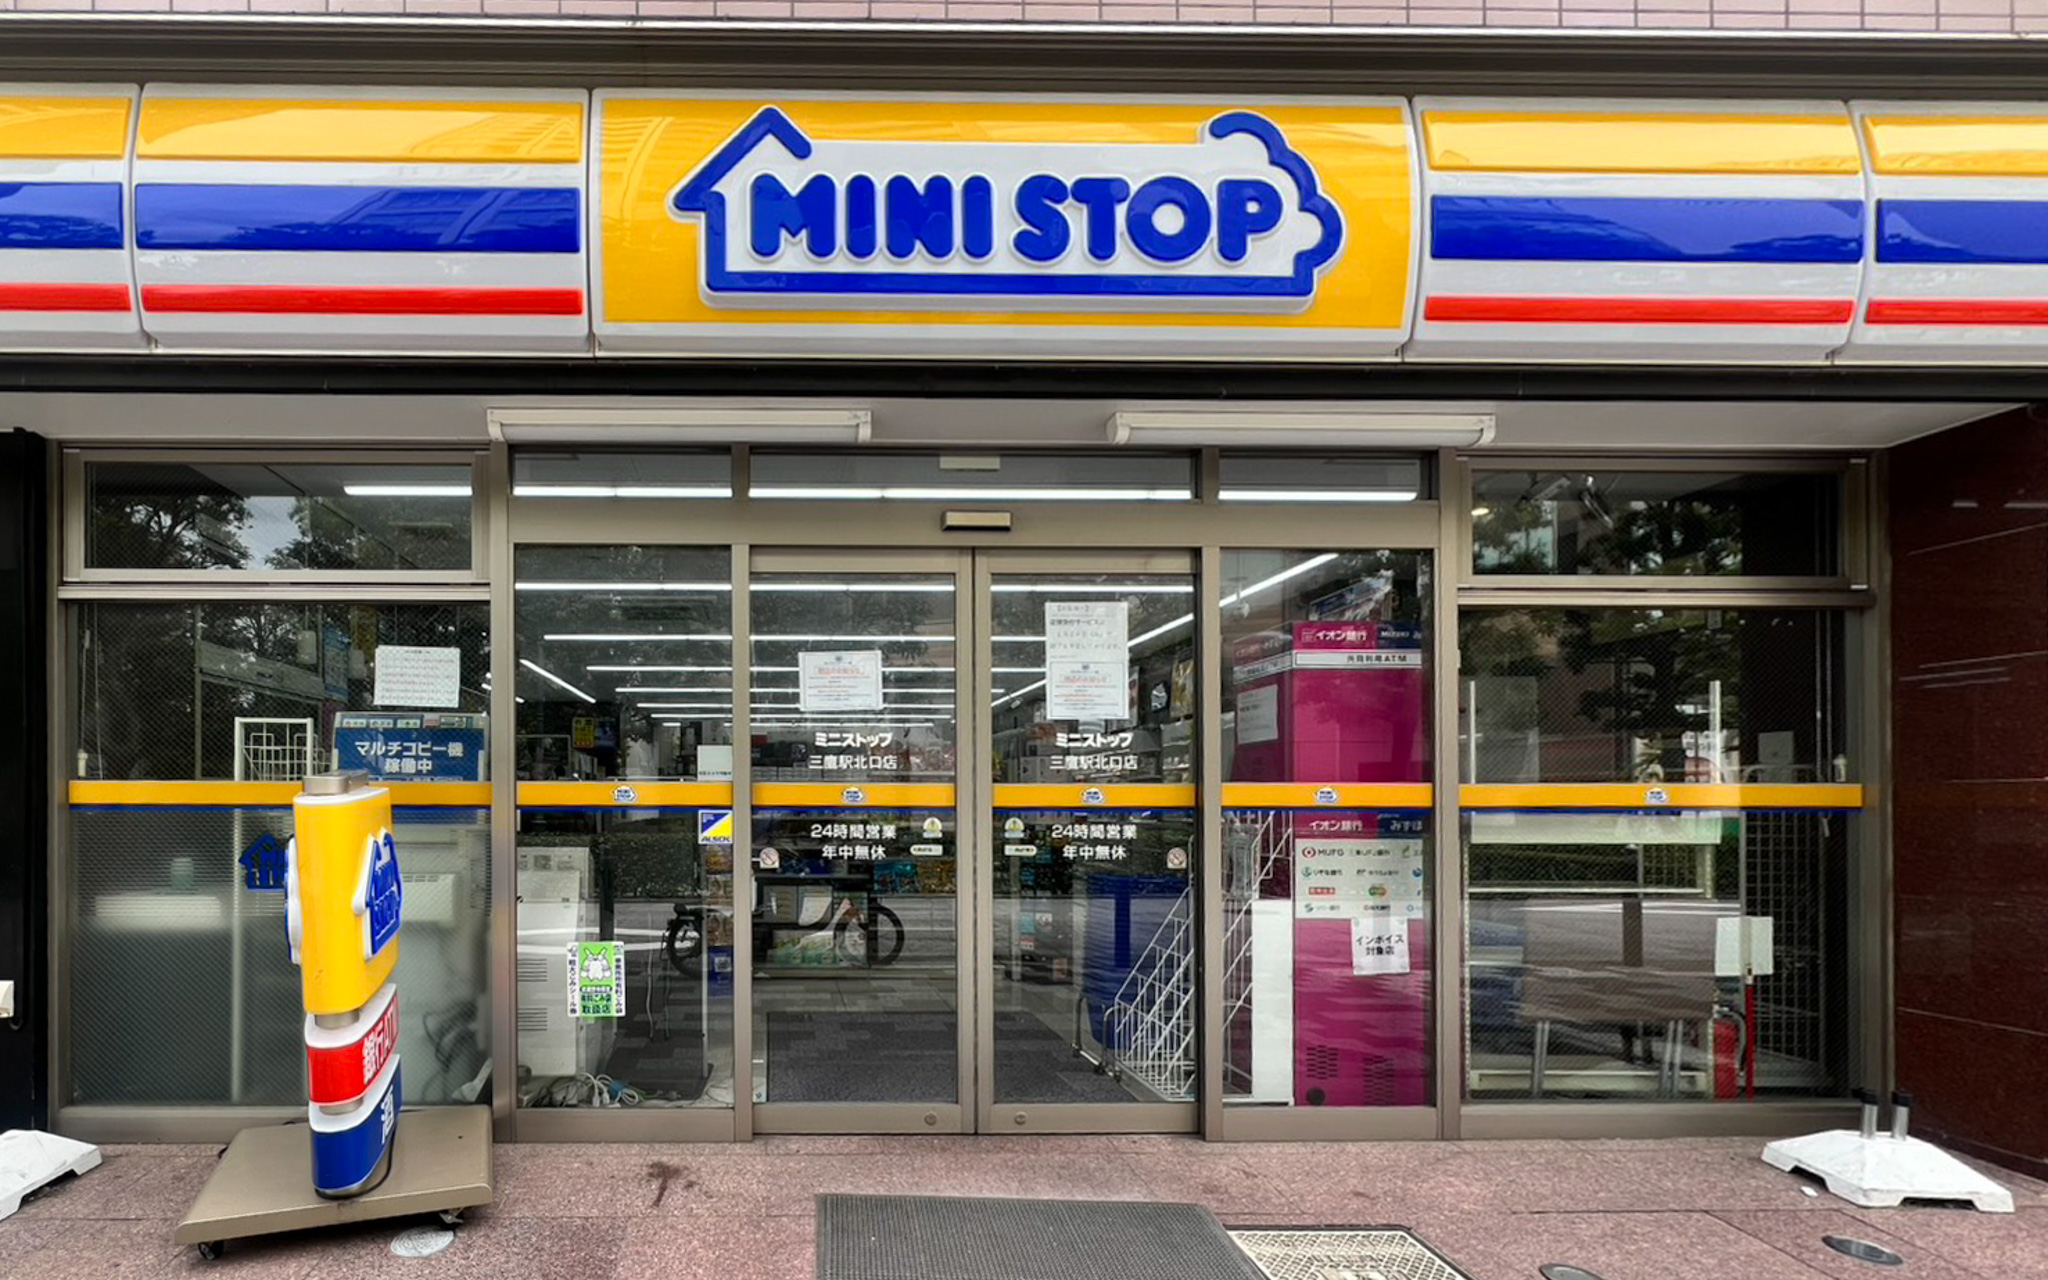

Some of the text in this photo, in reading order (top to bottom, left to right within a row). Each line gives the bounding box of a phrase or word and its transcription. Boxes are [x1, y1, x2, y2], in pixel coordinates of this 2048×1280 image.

[749, 172, 1284, 262] MINI STOP
[814, 732, 893, 747] ミニストップ
[1055, 732, 1134, 748] ミニストップ
[354, 741, 464, 757] マルチコピー機
[385, 758, 432, 773] 稼働中
[808, 755, 897, 769] 三鷹駅北口店
[1050, 755, 1138, 770] 三鷹駅北口店
[810, 824, 896, 839] 24時間営業
[1051, 824, 1137, 839] 24時間営業
[1309, 820, 1363, 832] イオン銀行
[822, 845, 886, 860] 年中無休
[1062, 845, 1127, 860] 年中無休
[1356, 934, 1405, 946] インボイス
[380, 1084, 395, 1145] 酒
